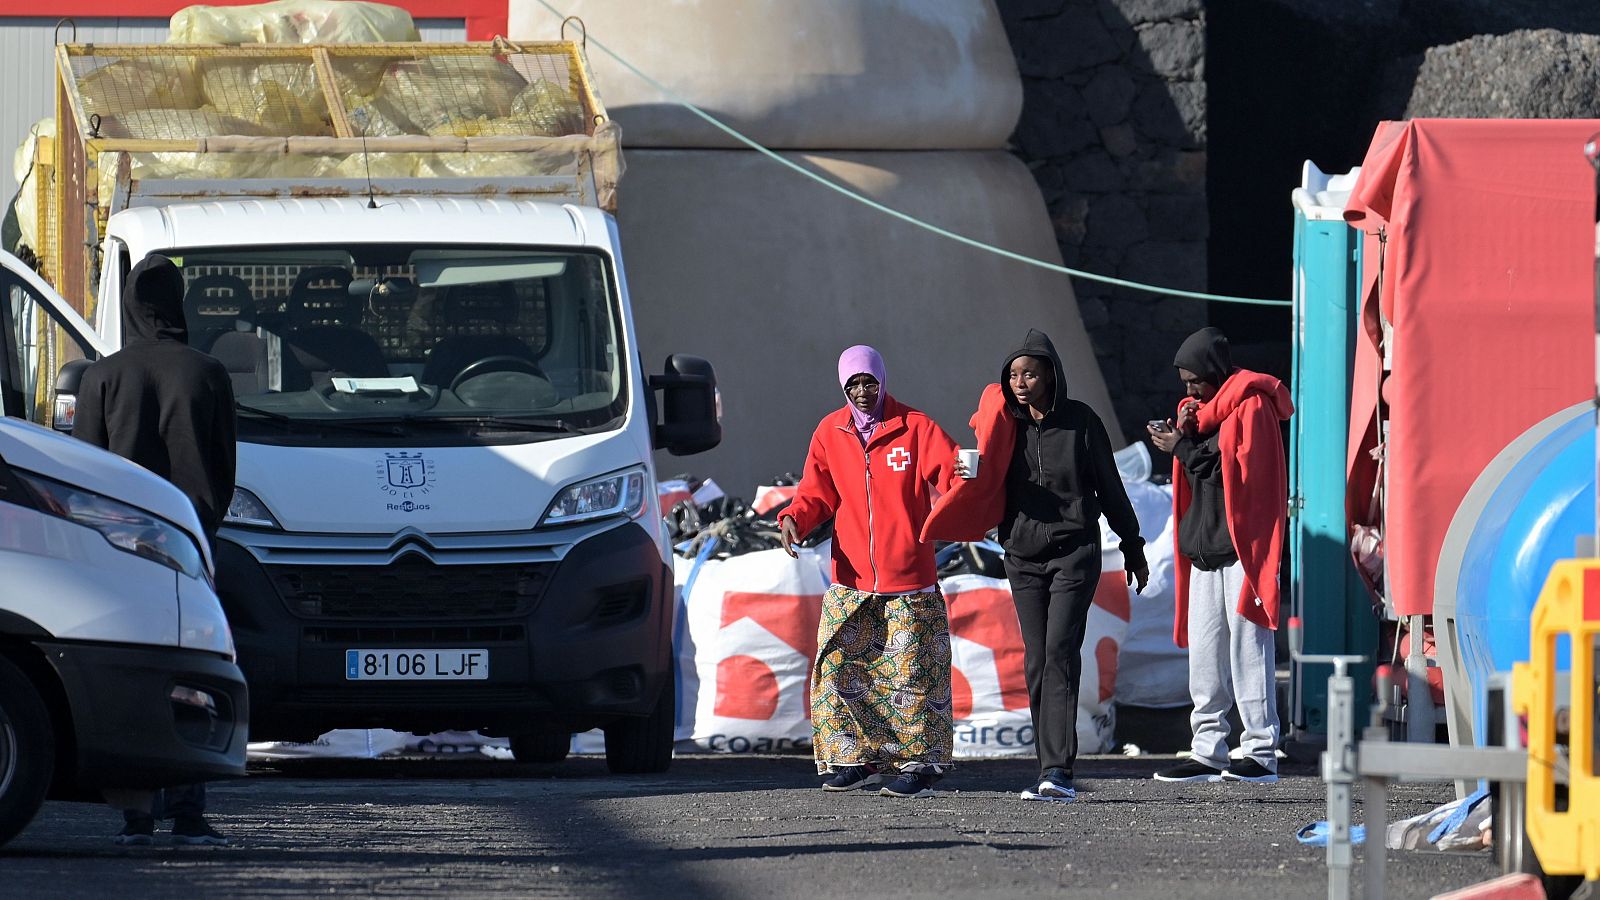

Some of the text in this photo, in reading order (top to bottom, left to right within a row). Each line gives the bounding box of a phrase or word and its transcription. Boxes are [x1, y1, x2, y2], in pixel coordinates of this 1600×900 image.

[386, 501, 431, 512] Residuos
[350, 667, 356, 675] E
[363, 653, 482, 676] 8106 LJF
[708, 734, 812, 753] coarc
[952, 724, 1035, 747] arco
